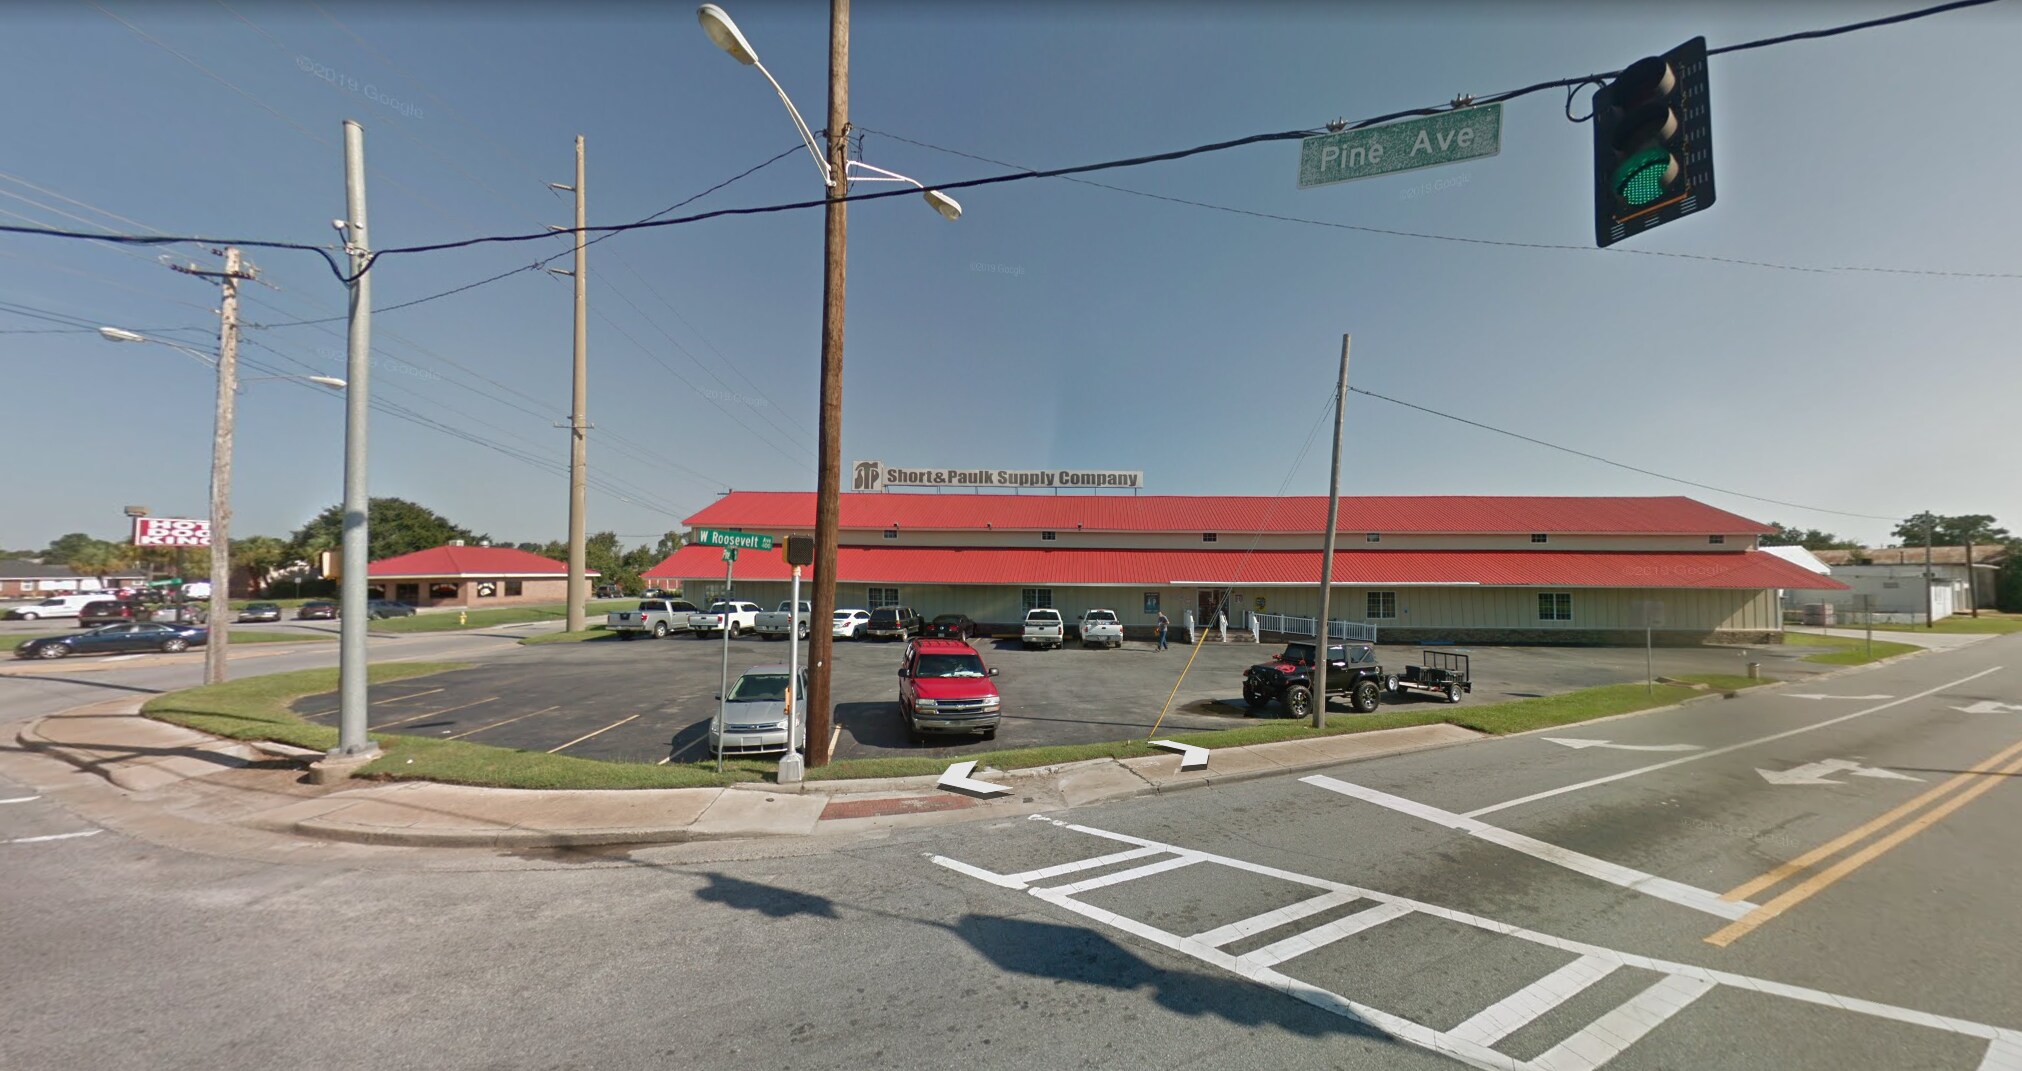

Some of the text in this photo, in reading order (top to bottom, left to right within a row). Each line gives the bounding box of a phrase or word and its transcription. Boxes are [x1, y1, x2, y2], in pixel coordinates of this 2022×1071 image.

[1320, 127, 1474, 172] Pine Ave
[887, 469, 1138, 487] Short&Paulk Supply Company
[700, 530, 708, 542] W
[712, 532, 758, 548] Roosevelt
